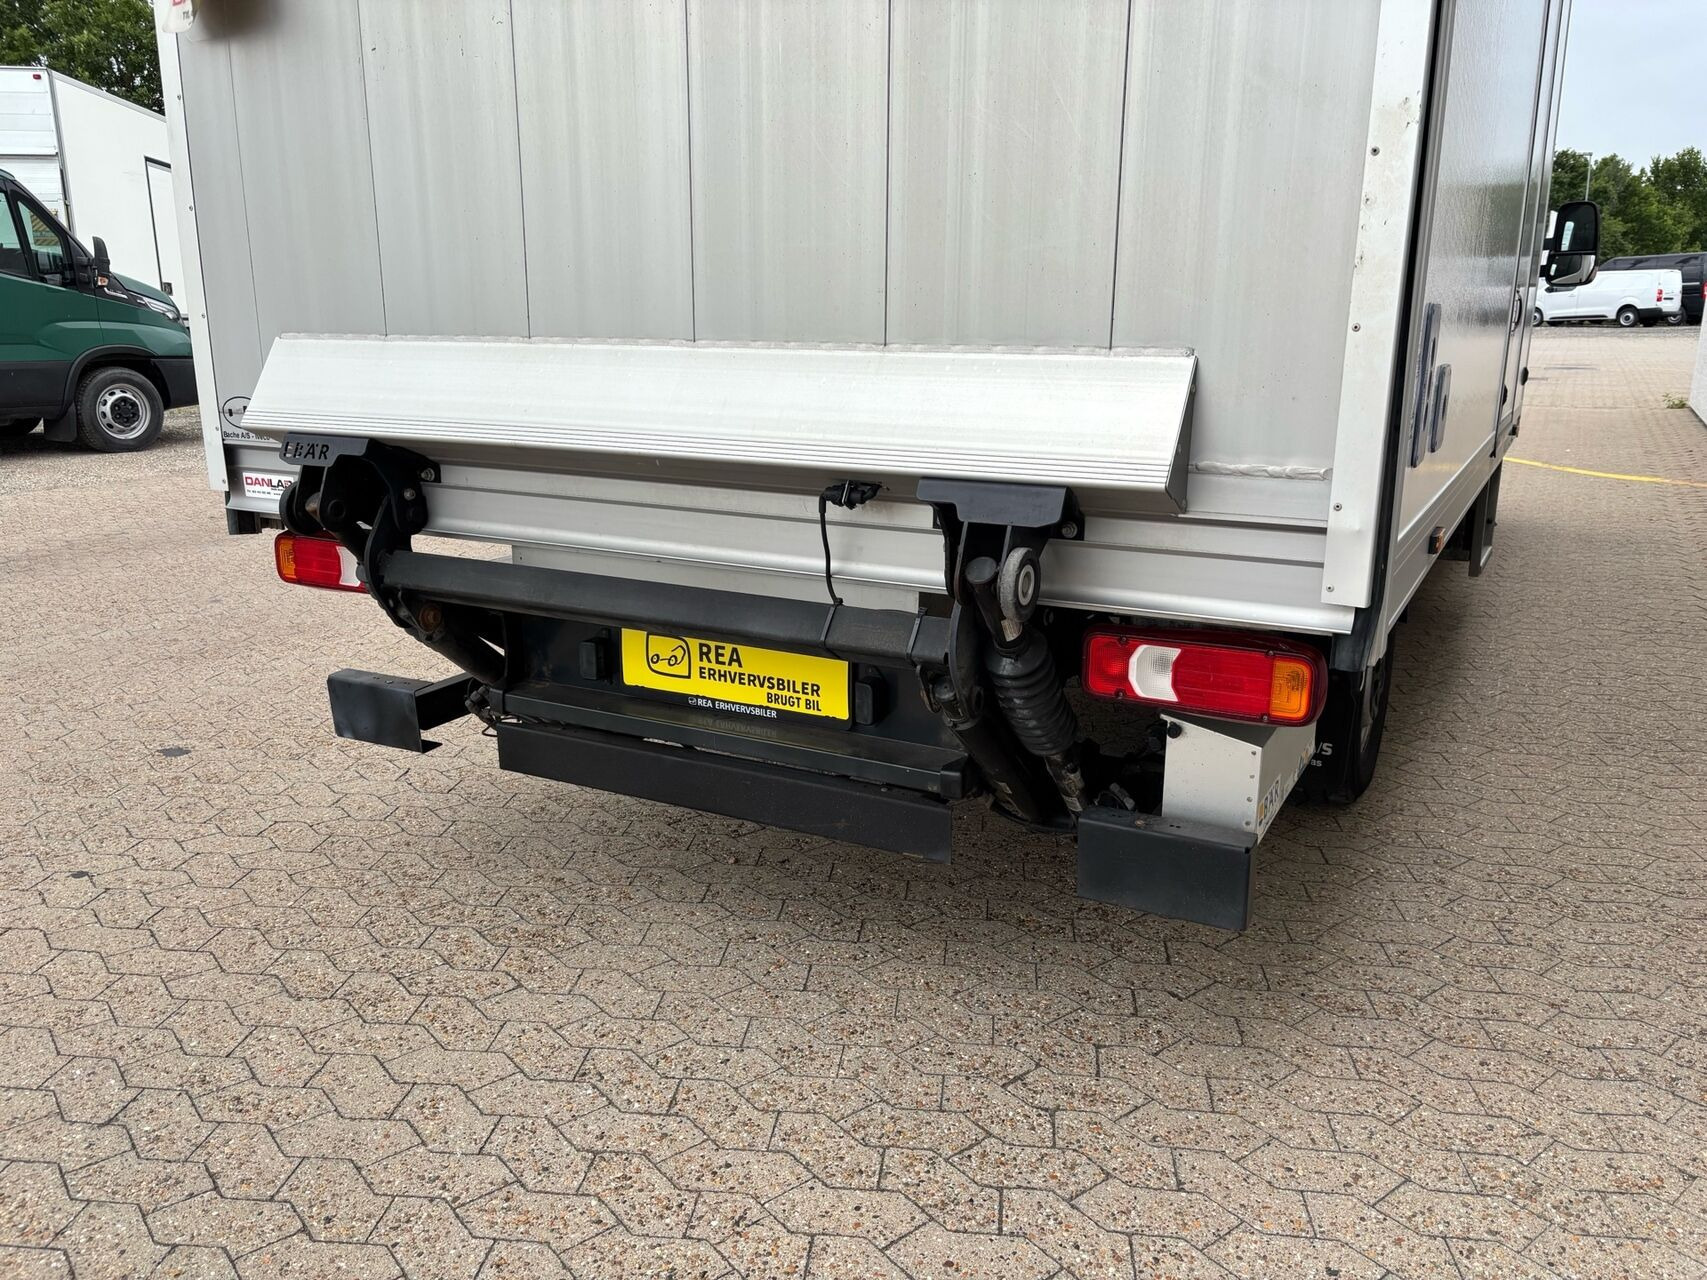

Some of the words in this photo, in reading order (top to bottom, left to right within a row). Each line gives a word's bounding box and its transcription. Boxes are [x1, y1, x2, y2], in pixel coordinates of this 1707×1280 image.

[698, 642, 743, 668] REA
[698, 667, 821, 697] ERHVERVSBILER
[697, 698, 713, 709] REA
[715, 701, 777, 719] ERHVERVSBILER
[766, 692, 801, 709] BRUGT
[804, 698, 822, 712] BIL
